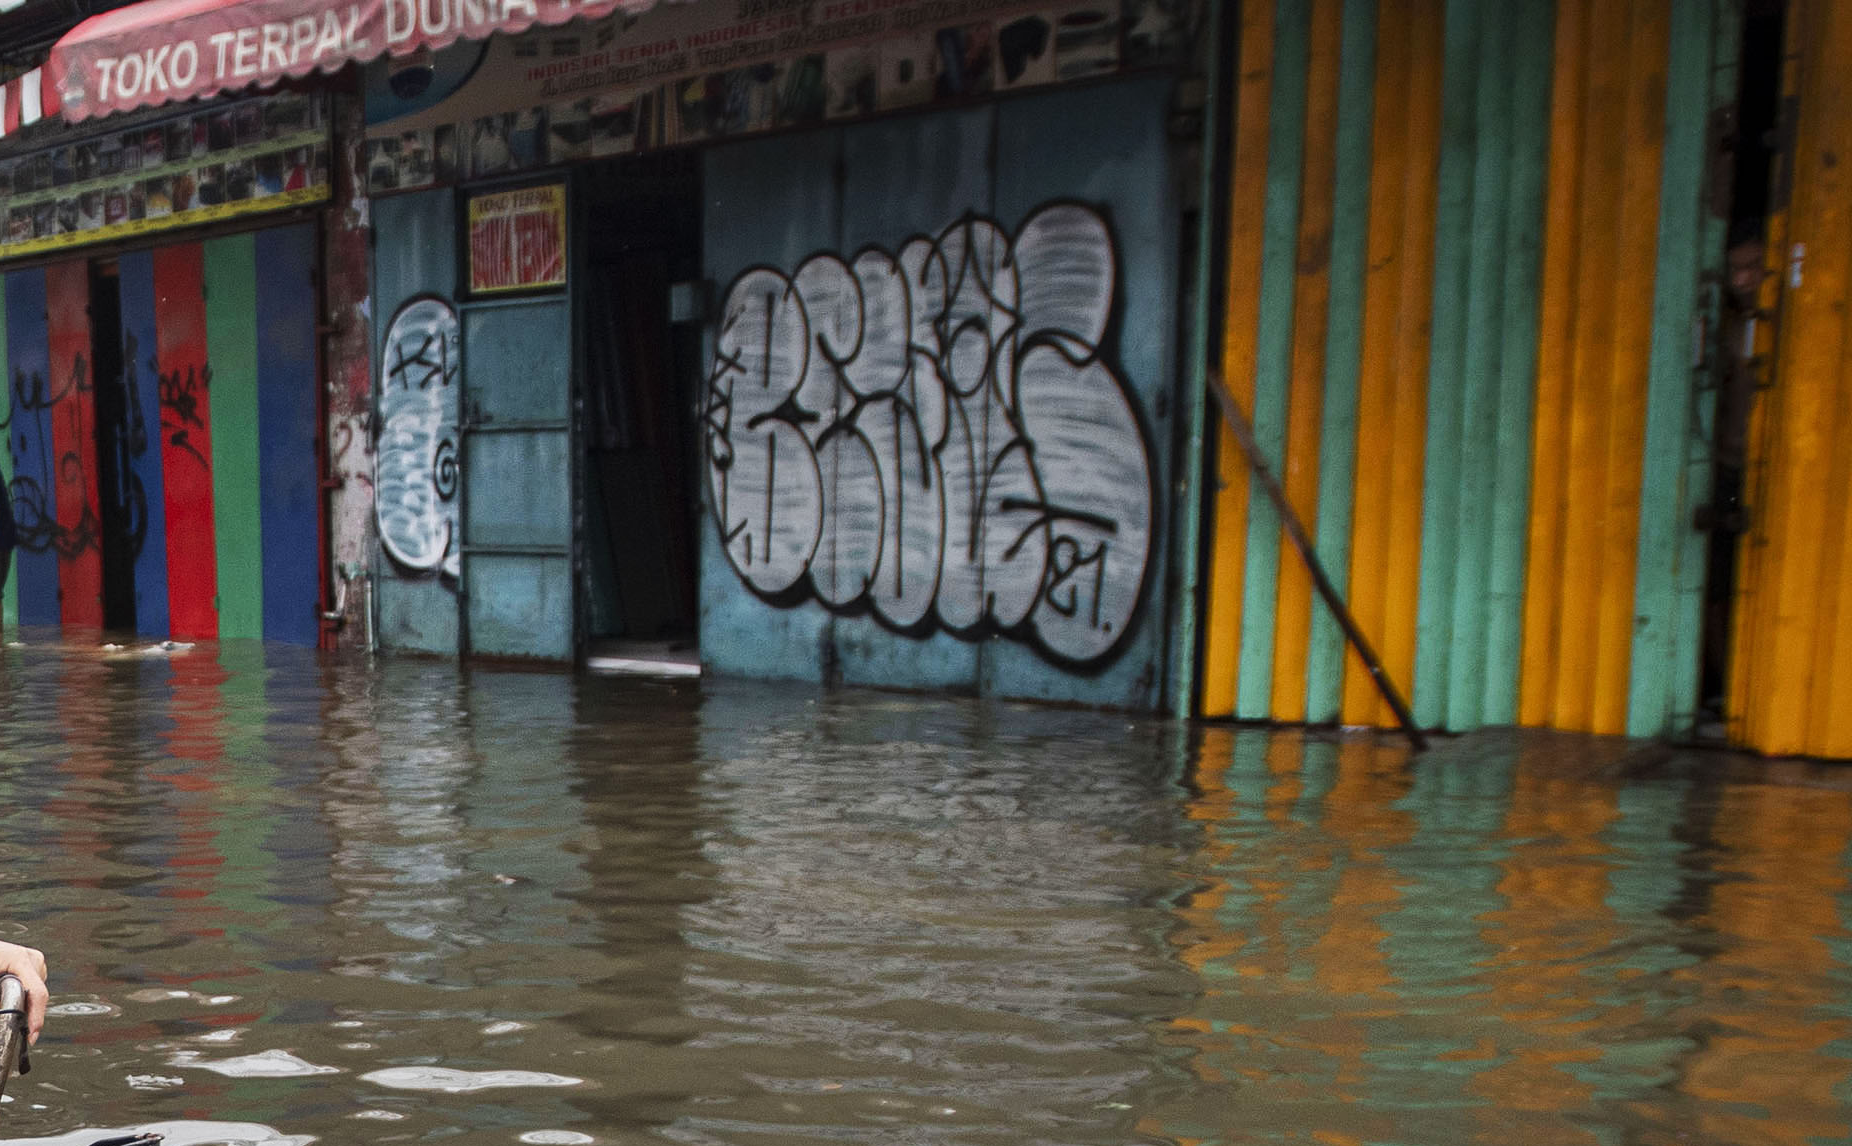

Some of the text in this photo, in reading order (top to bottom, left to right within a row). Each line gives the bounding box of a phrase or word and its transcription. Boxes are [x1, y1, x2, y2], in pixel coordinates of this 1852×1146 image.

[96, 42, 199, 101] TOKO
[209, 7, 370, 80] TERPAL
[527, 51, 610, 82] INDUSTRI
[618, 37, 680, 64] TENDA
